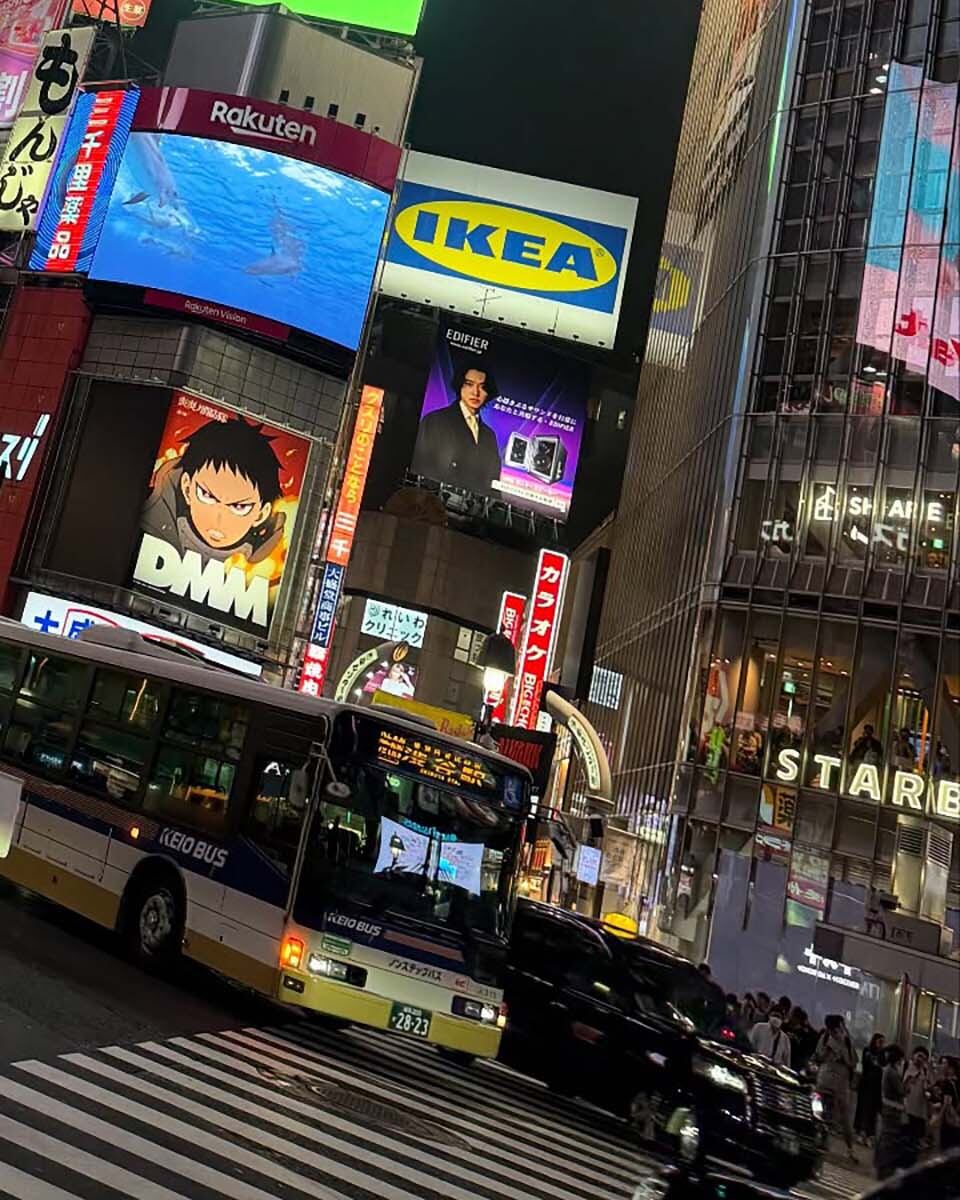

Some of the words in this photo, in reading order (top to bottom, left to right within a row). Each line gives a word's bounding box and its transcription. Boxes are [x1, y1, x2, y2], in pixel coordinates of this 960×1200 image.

[210, 100, 317, 146] Rakuten
[48, 96, 113, 260] 三千里薬品
[413, 210, 599, 282] IKEA
[184, 299, 219, 317] Rakuten
[445, 328, 489, 350] EDIFIER
[849, 497, 943, 522] SHARE
[133, 533, 269, 628] DMM
[381, 608, 425, 630] れいわ
[526, 566, 560, 662] カラオケ
[364, 620, 423, 644] クリニック
[194, 841, 228, 869] BUS
[356, 920, 382, 937] BUS
[389, 958, 441, 981] ノンステップバス
